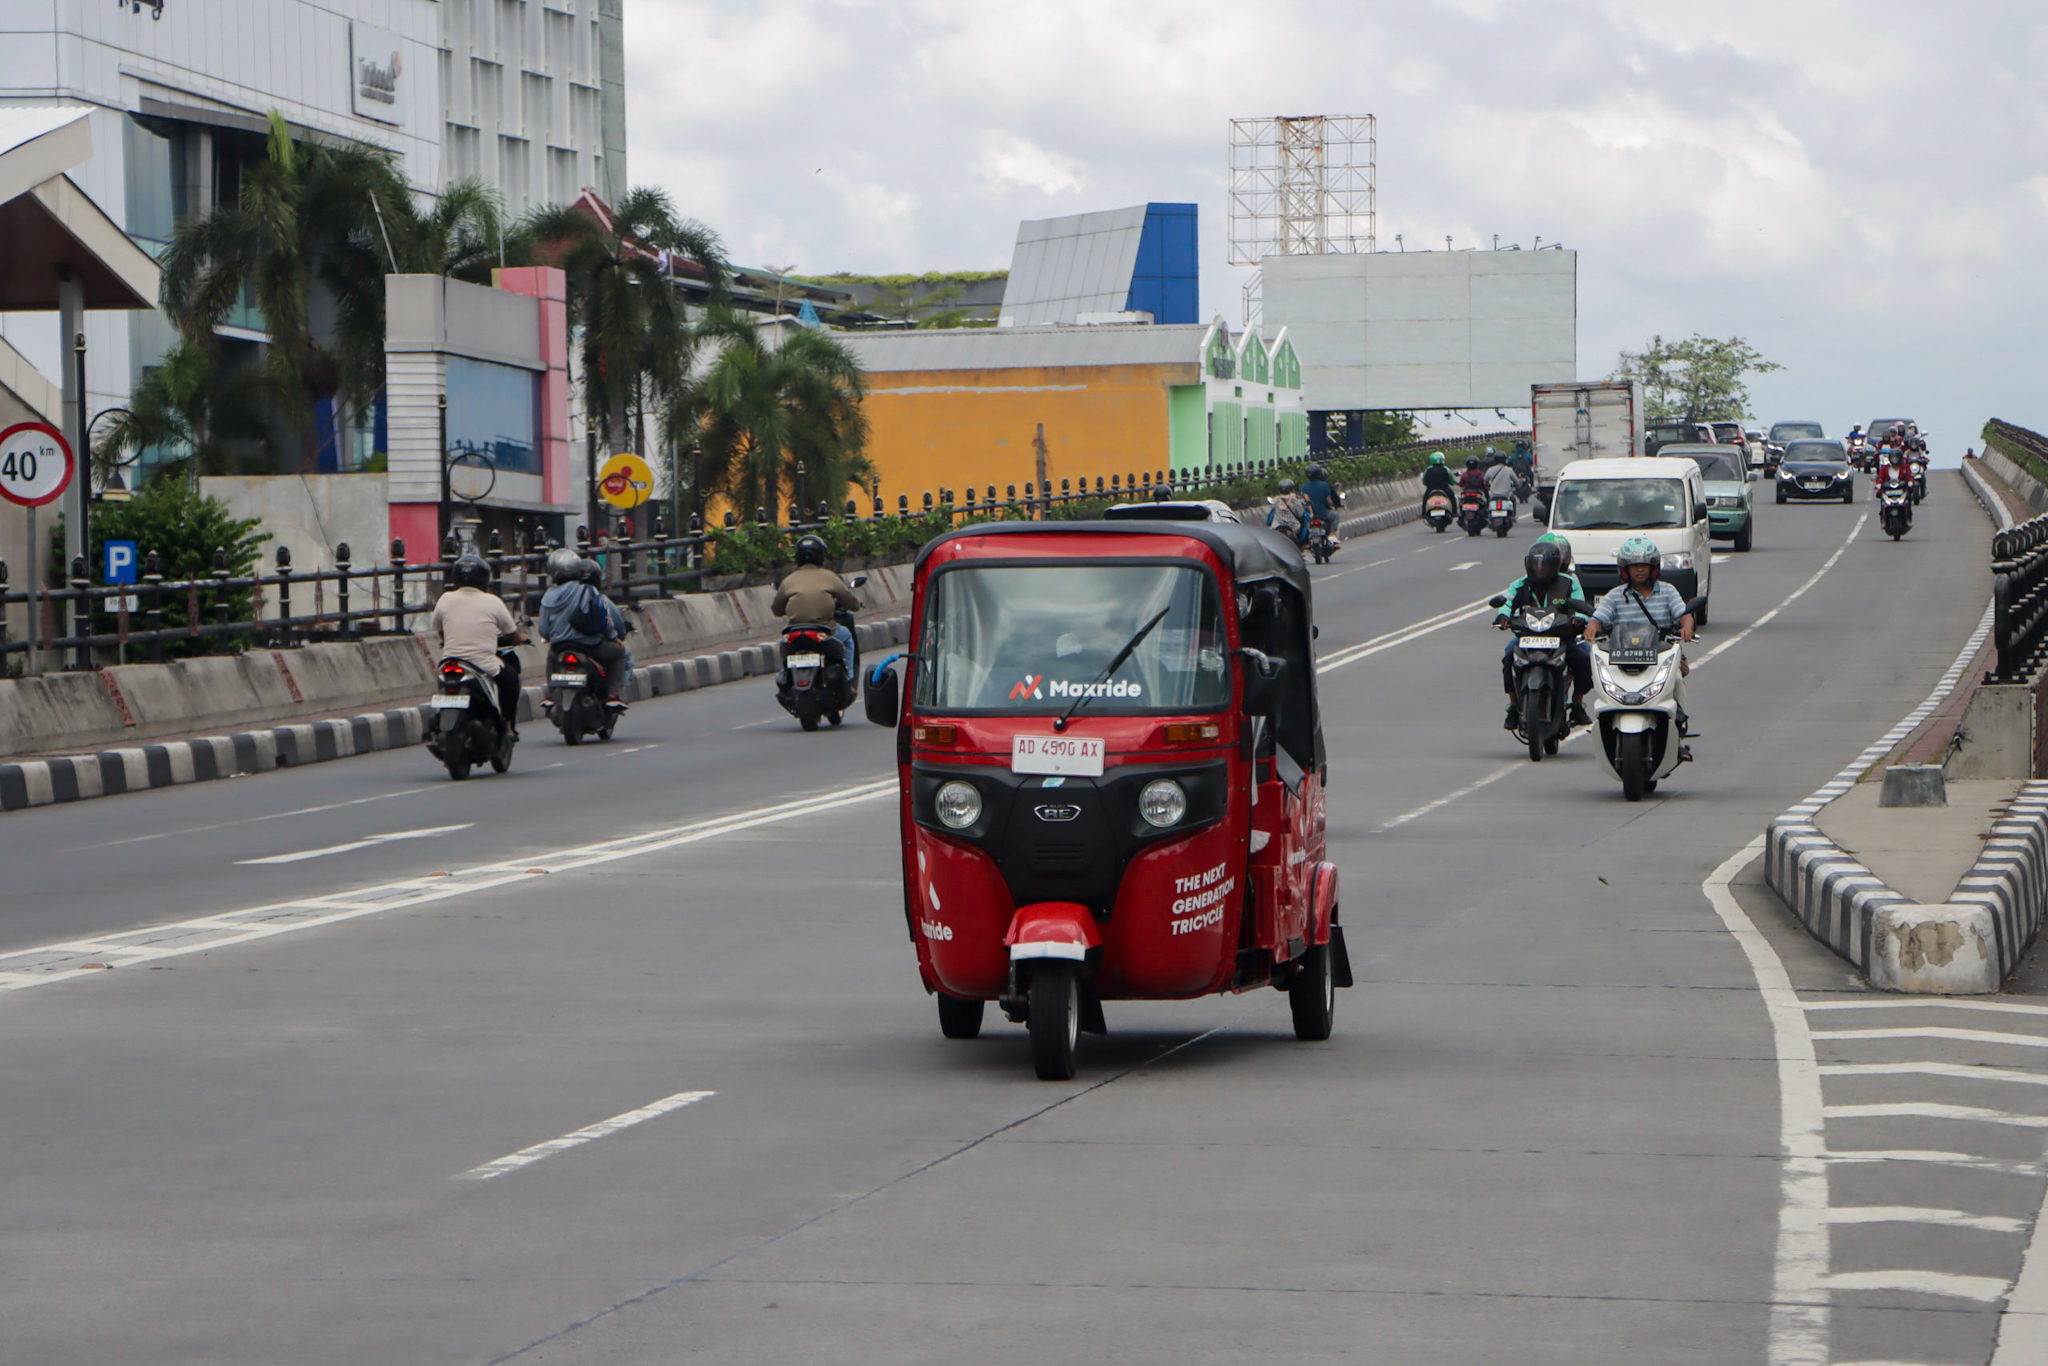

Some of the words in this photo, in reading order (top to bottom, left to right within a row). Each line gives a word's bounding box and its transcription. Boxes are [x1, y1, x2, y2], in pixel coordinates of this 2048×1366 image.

[2, 451, 37, 482] 40
[39, 446, 54, 457] km
[109, 546, 132, 577] P
[1049, 679, 1142, 698] Maxride
[1019, 739, 1035, 754] AD
[1042, 740, 1075, 756] 4590
[1081, 742, 1098, 757] AX
[1044, 809, 1071, 819] RE
[1175, 873, 1201, 894] THE
[1202, 862, 1226, 887] NEXT
[1172, 875, 1235, 915] GENERATION
[1171, 904, 1224, 936] TRICYCLE
